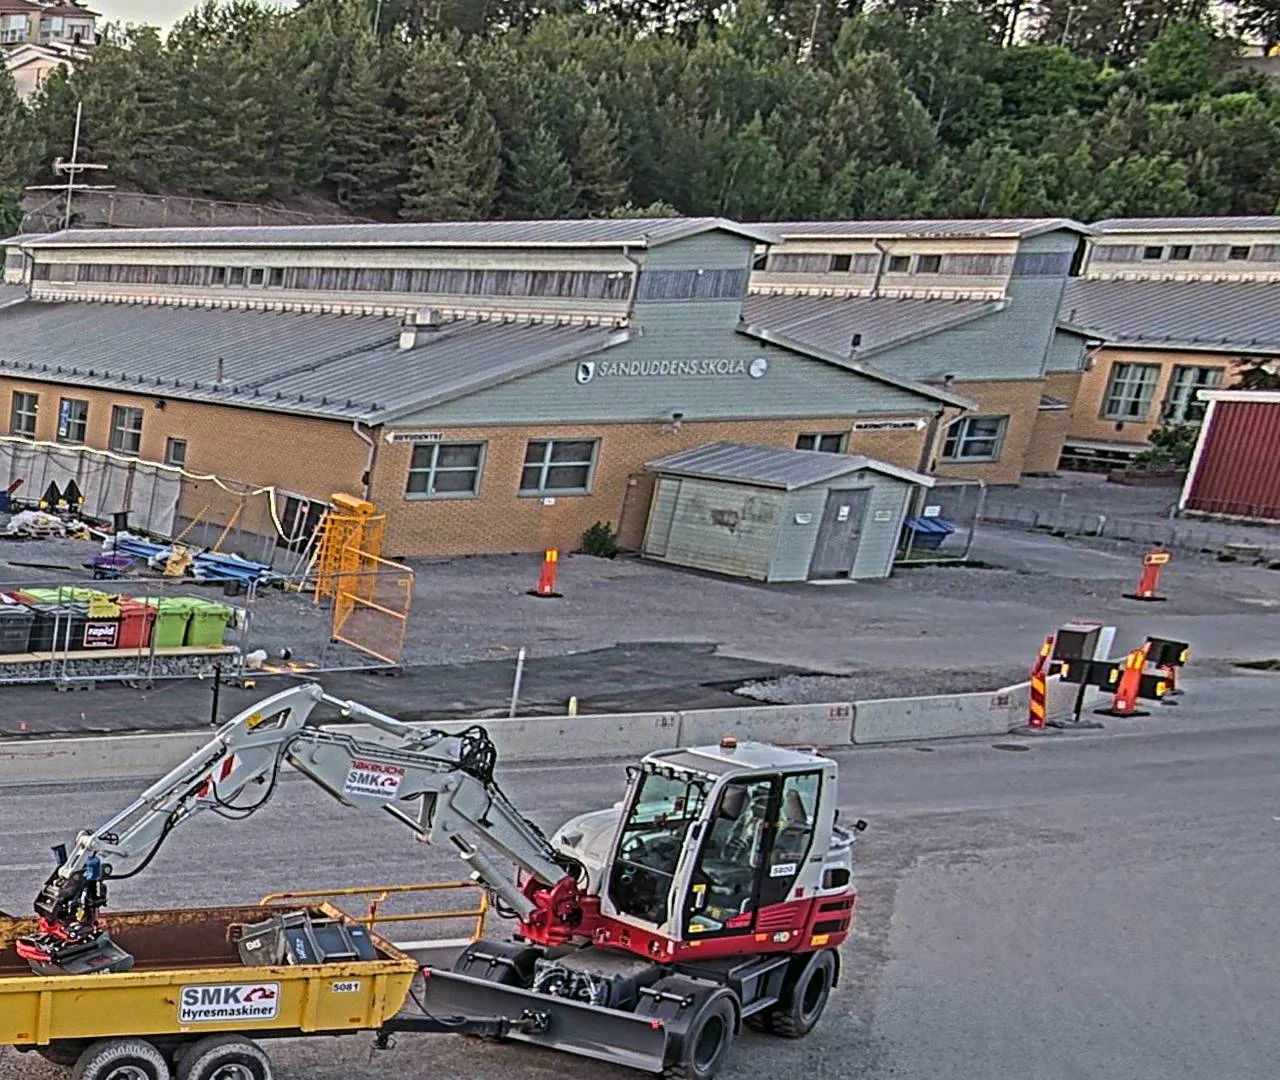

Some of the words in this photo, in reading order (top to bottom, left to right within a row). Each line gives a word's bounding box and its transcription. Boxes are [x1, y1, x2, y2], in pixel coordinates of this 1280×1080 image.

[599, 359, 697, 377] SANDUDDENS
[700, 358, 745, 374] SKOLA
[348, 771, 380, 787] SMK
[183, 987, 243, 1006] SMK
[182, 1004, 275, 1019] Hyresmaskiner
